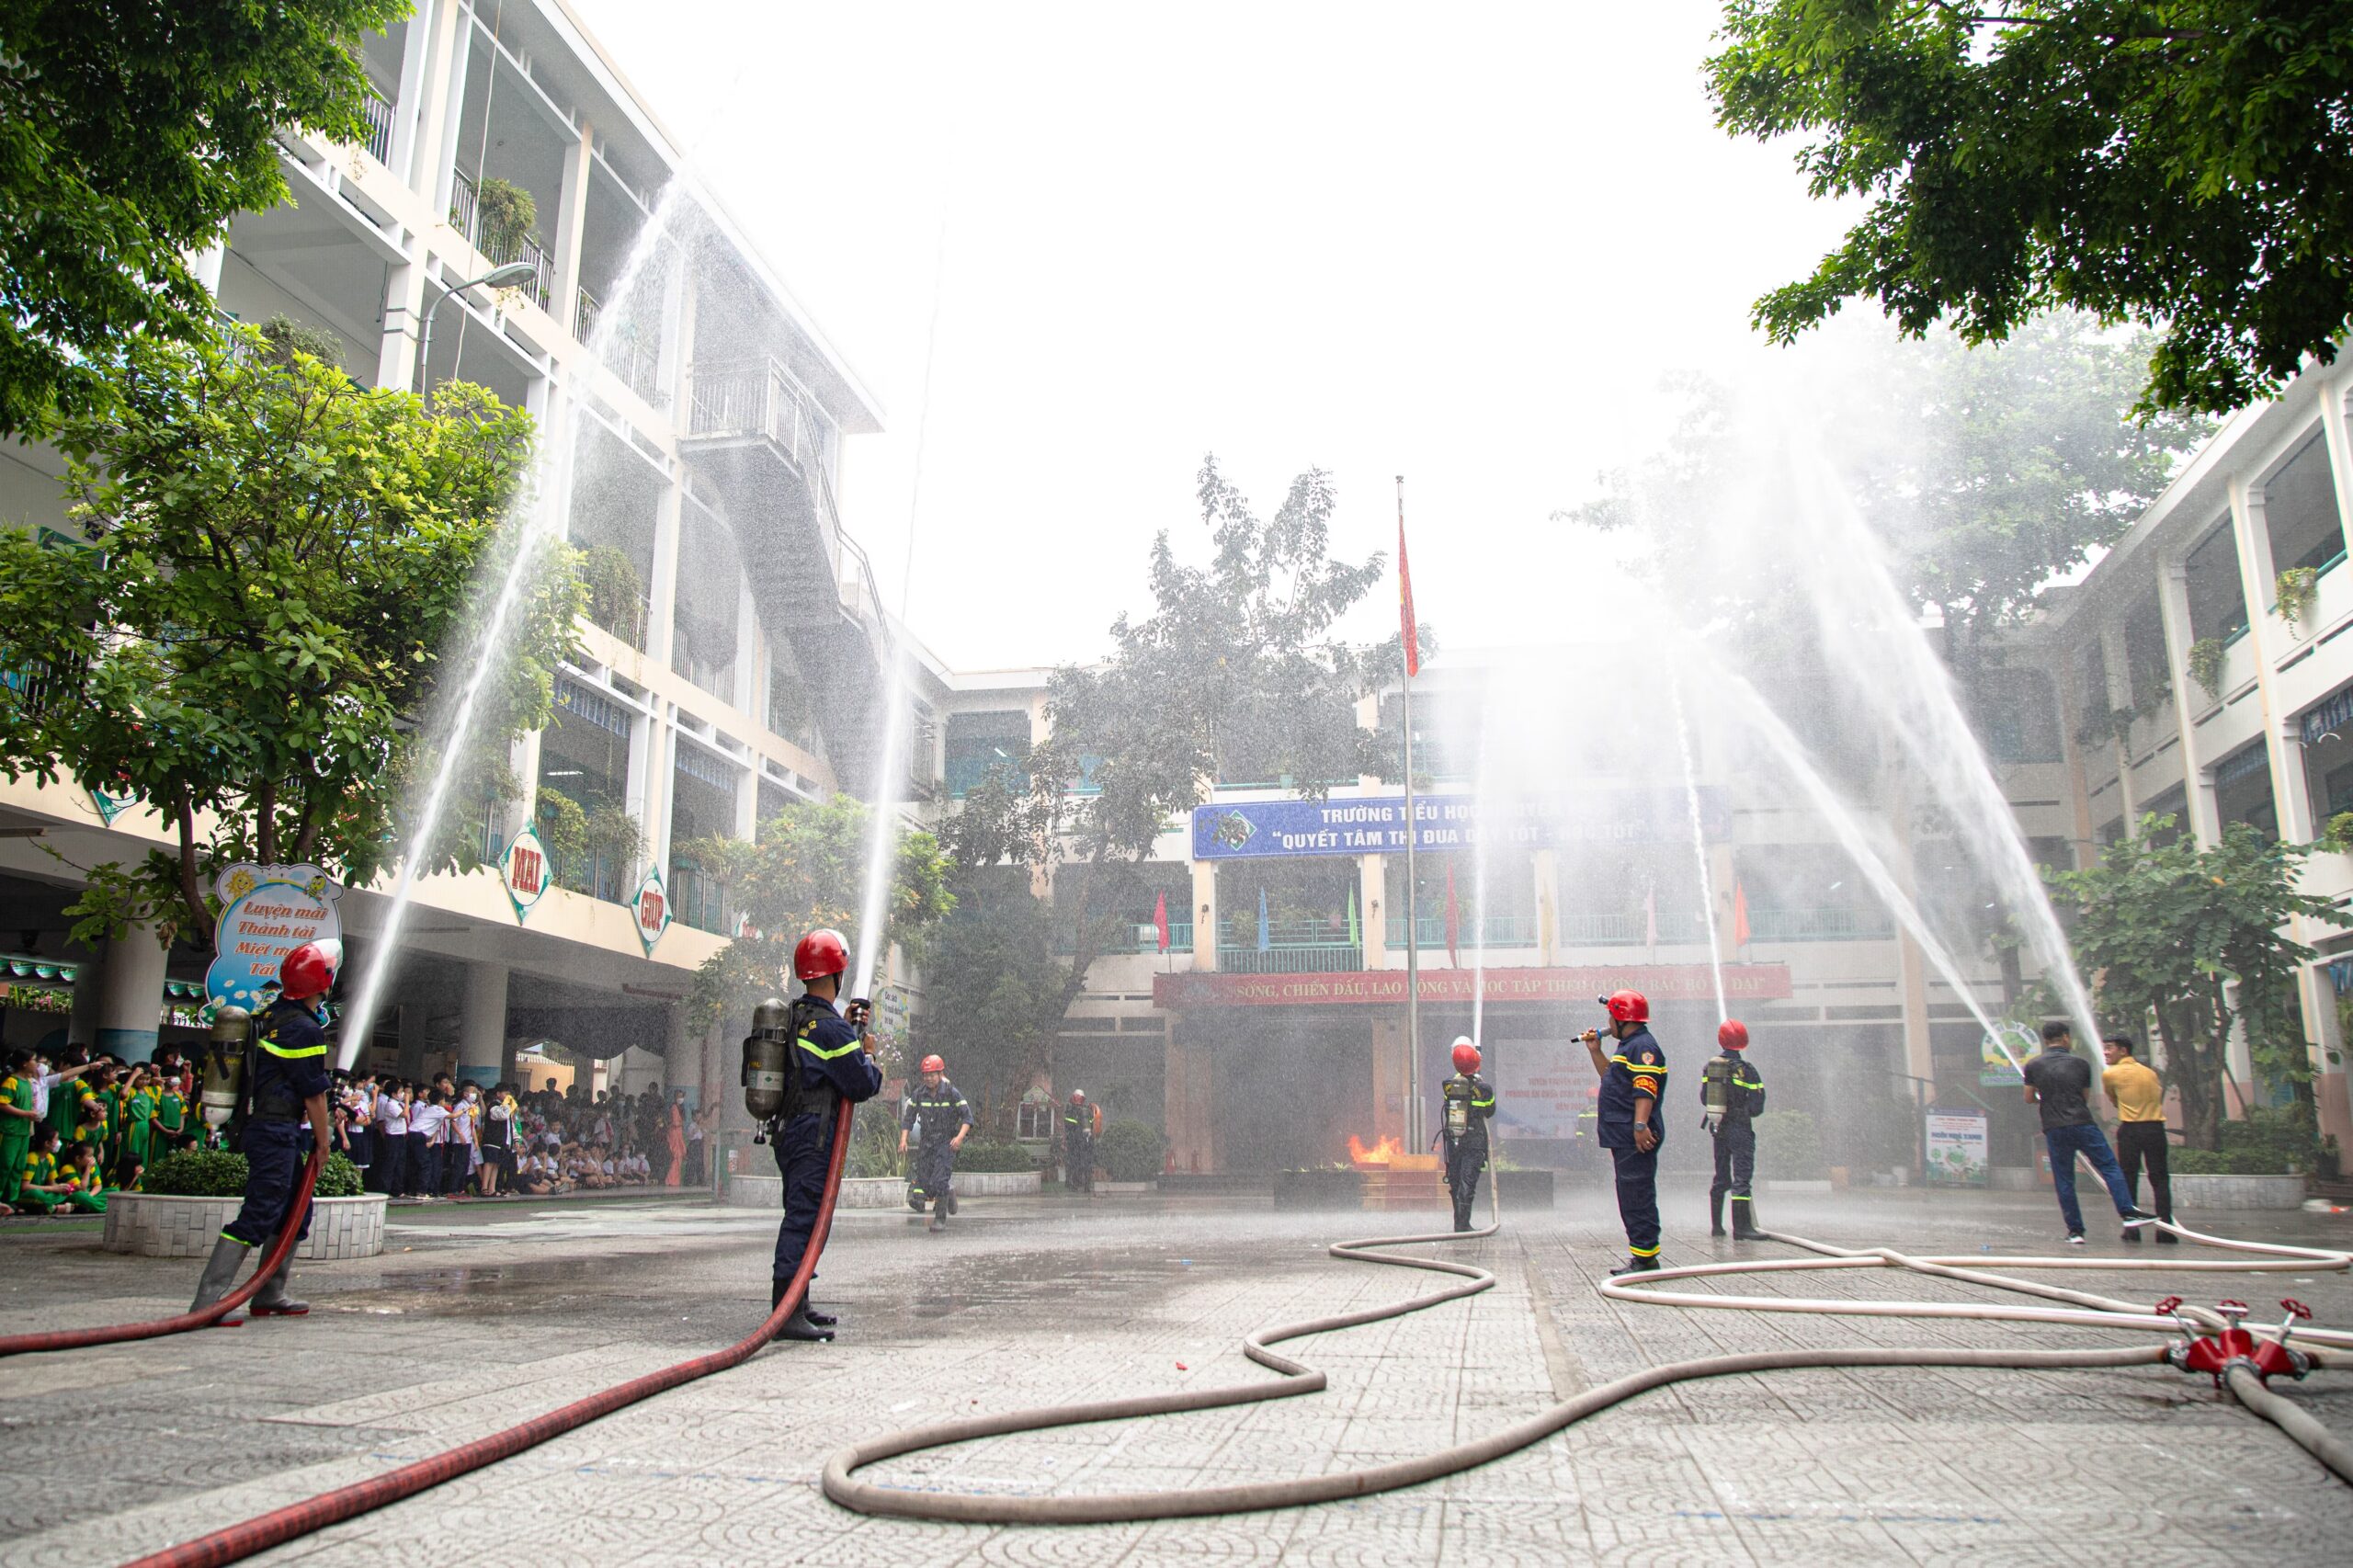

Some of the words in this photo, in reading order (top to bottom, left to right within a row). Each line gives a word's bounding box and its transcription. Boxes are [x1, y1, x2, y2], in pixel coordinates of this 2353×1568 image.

[1321, 803, 1392, 824] TRƯỜNG
[1344, 830, 1381, 846] TÂM
[1423, 829, 1460, 845] ĐUA
[243, 902, 292, 920] Luyện
[641, 887, 664, 932] GIÚP
[238, 921, 290, 937] Thành
[292, 925, 317, 939] tài
[235, 942, 272, 959] Miệt
[250, 962, 277, 976] Tất
[1283, 980, 1329, 996] CHIẾN
[1372, 982, 1402, 994] LAO
[1406, 978, 1449, 996] ỘNG
[1451, 977, 1472, 994] VÀ
[1511, 976, 1541, 995] TẬP
